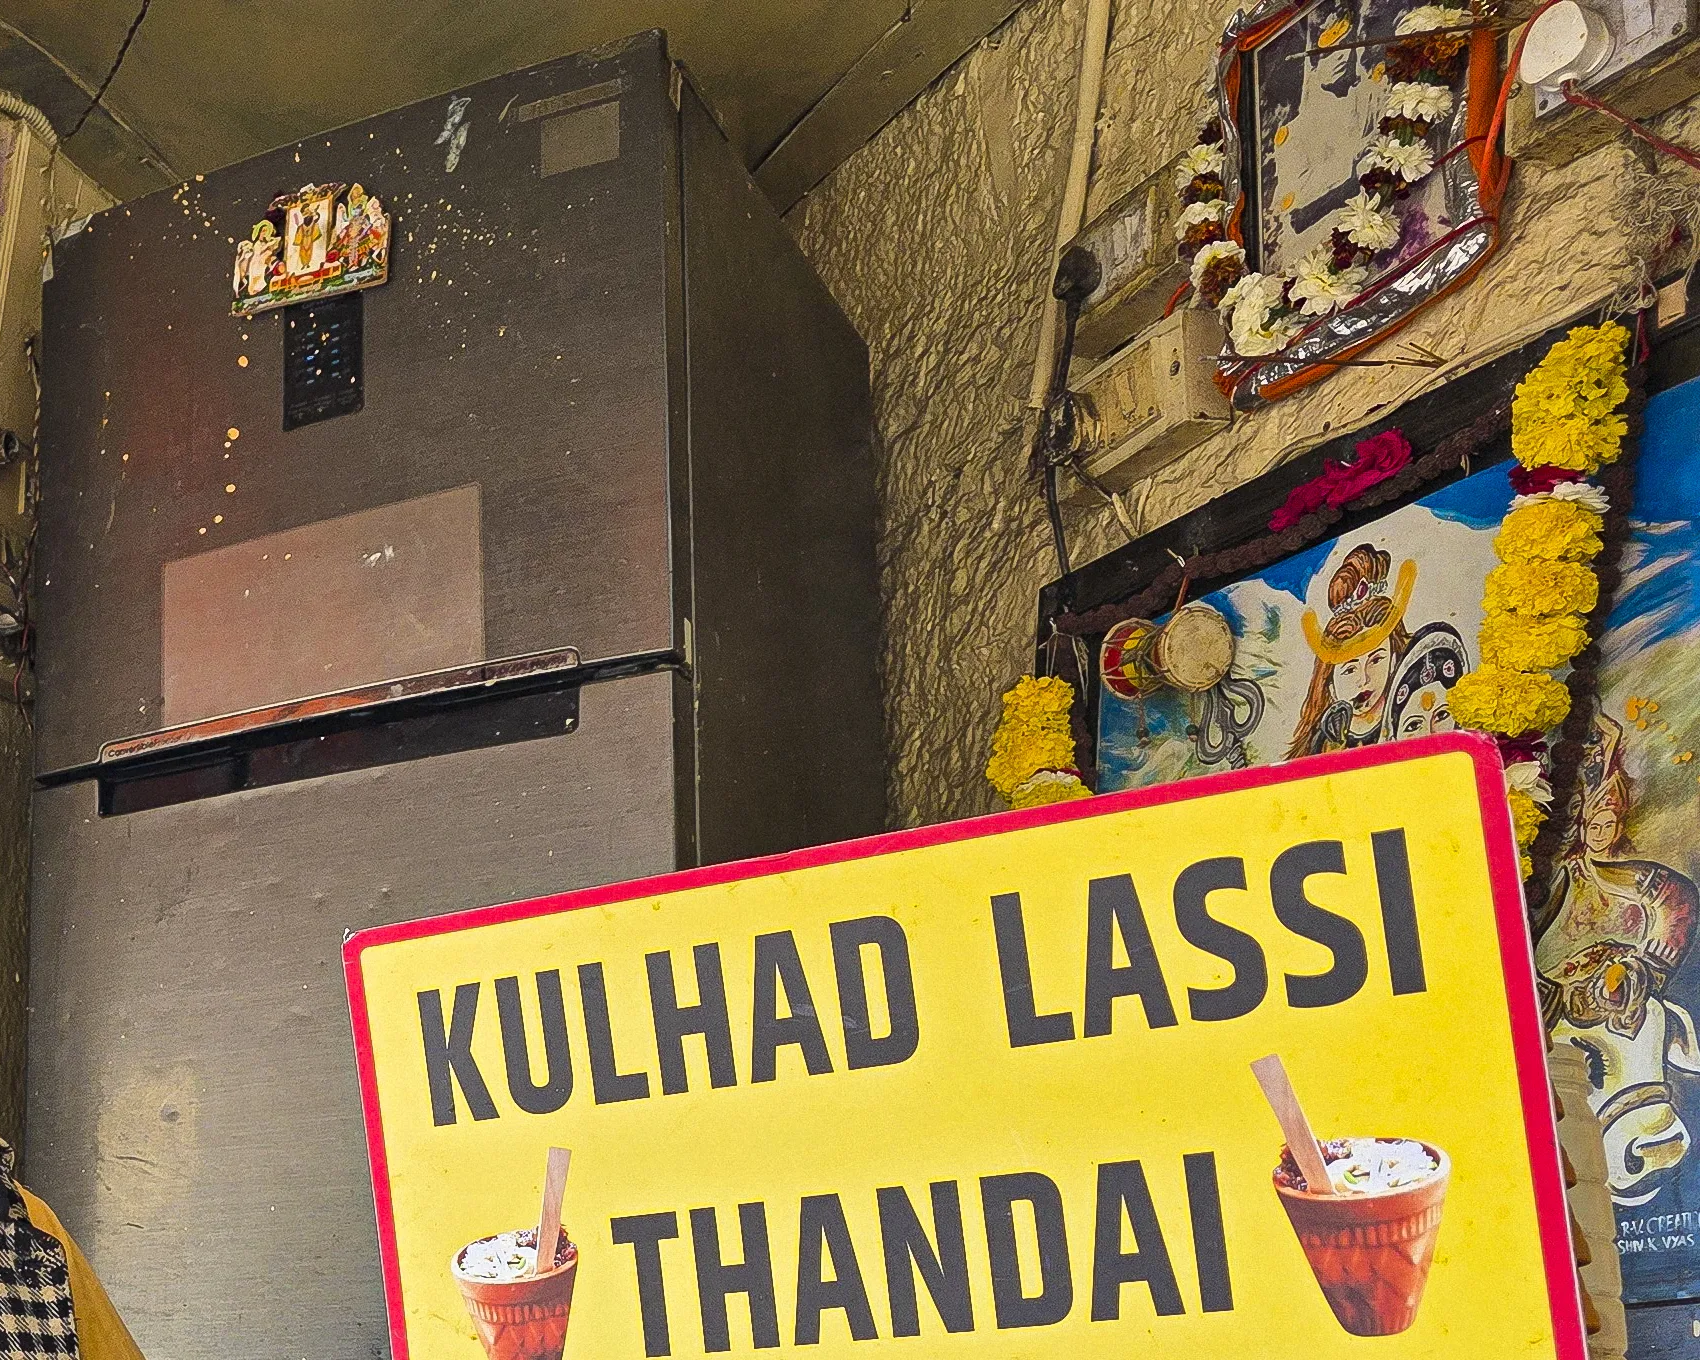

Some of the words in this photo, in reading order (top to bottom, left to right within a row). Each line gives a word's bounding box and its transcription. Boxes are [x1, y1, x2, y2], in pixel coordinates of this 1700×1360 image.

[418, 914, 920, 1125] KULHAD
[990, 828, 1428, 1048] LASSI
[611, 1151, 1234, 1357] THANDAI
[1662, 1234, 1695, 1249] VYAS
